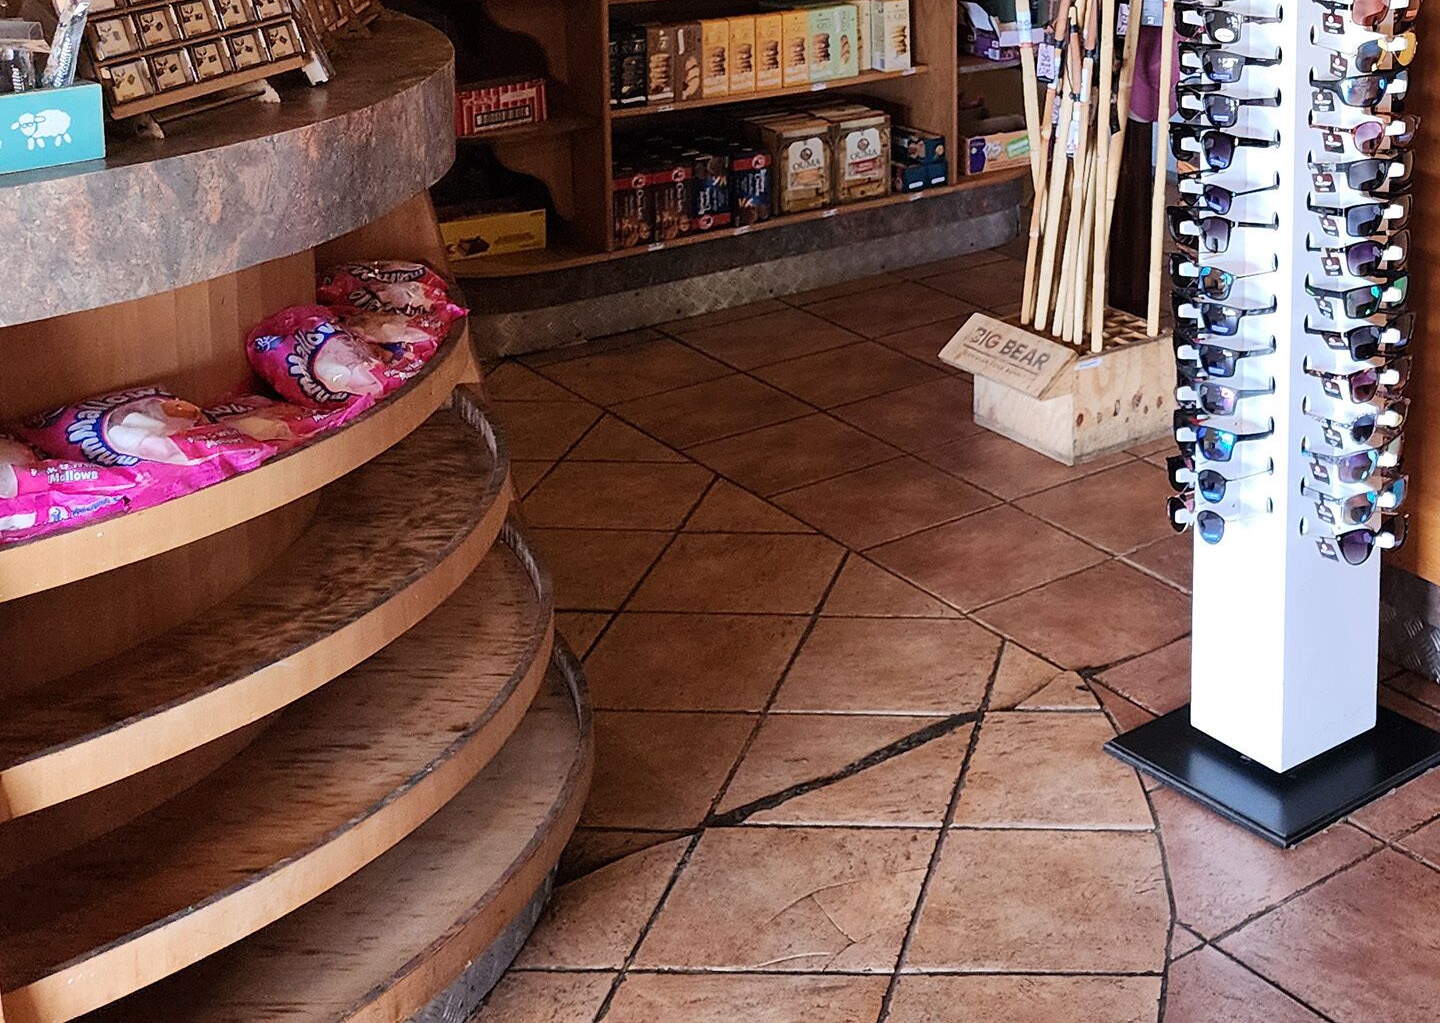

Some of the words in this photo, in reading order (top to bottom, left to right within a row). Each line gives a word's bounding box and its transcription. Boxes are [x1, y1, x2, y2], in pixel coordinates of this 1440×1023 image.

[850, 149, 878, 161] OUMA
[792, 159, 821, 171] OUMA
[998, 338, 1051, 371] BEAR
[48, 469, 99, 485] Mallows
